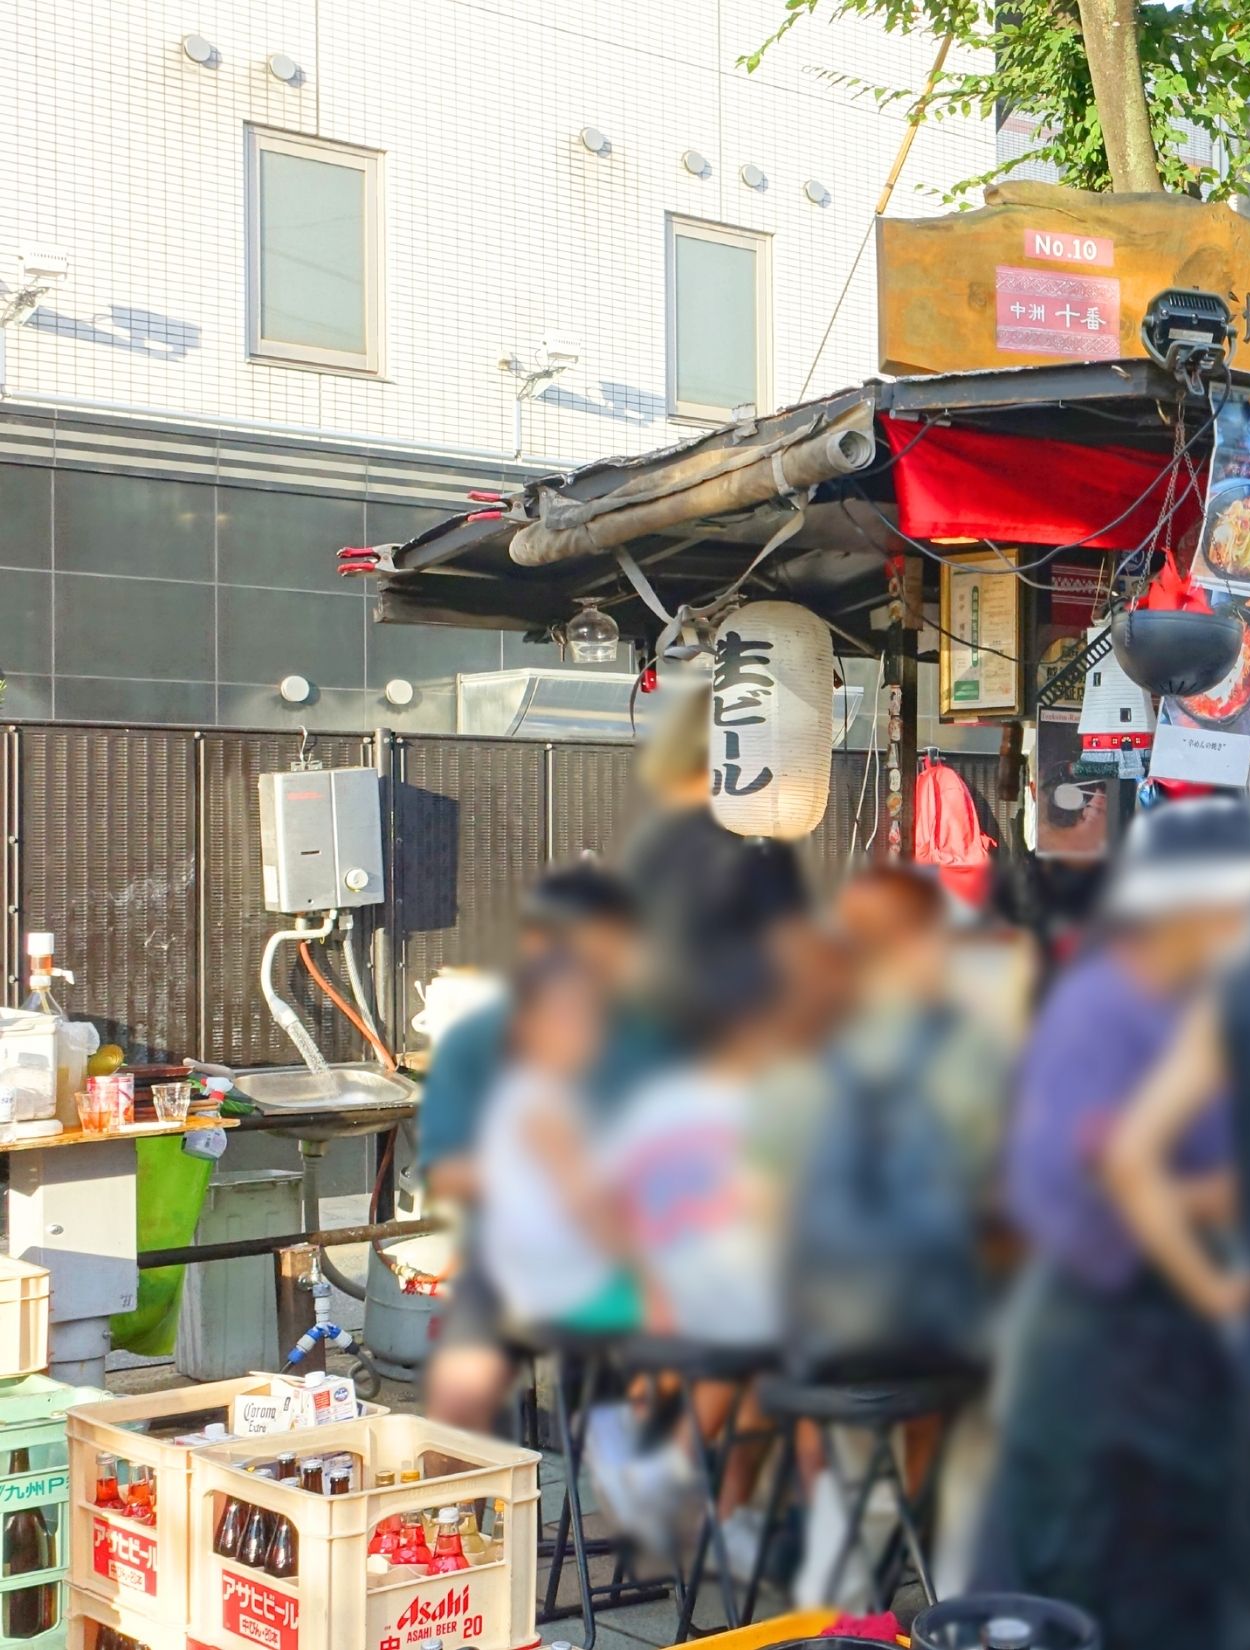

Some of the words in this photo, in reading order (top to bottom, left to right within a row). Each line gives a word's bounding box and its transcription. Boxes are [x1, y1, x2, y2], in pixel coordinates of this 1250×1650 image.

[1035, 234, 1097, 261] No.10
[713, 630, 775, 797] 生ビール
[243, 1401, 277, 1422] Corona
[223, 1574, 299, 1630] アサヒビール
[397, 1584, 470, 1630] Asahi
[407, 1626, 433, 1644] ASAHI
[436, 1621, 458, 1637] BEER
[463, 1614, 483, 1640] 20
